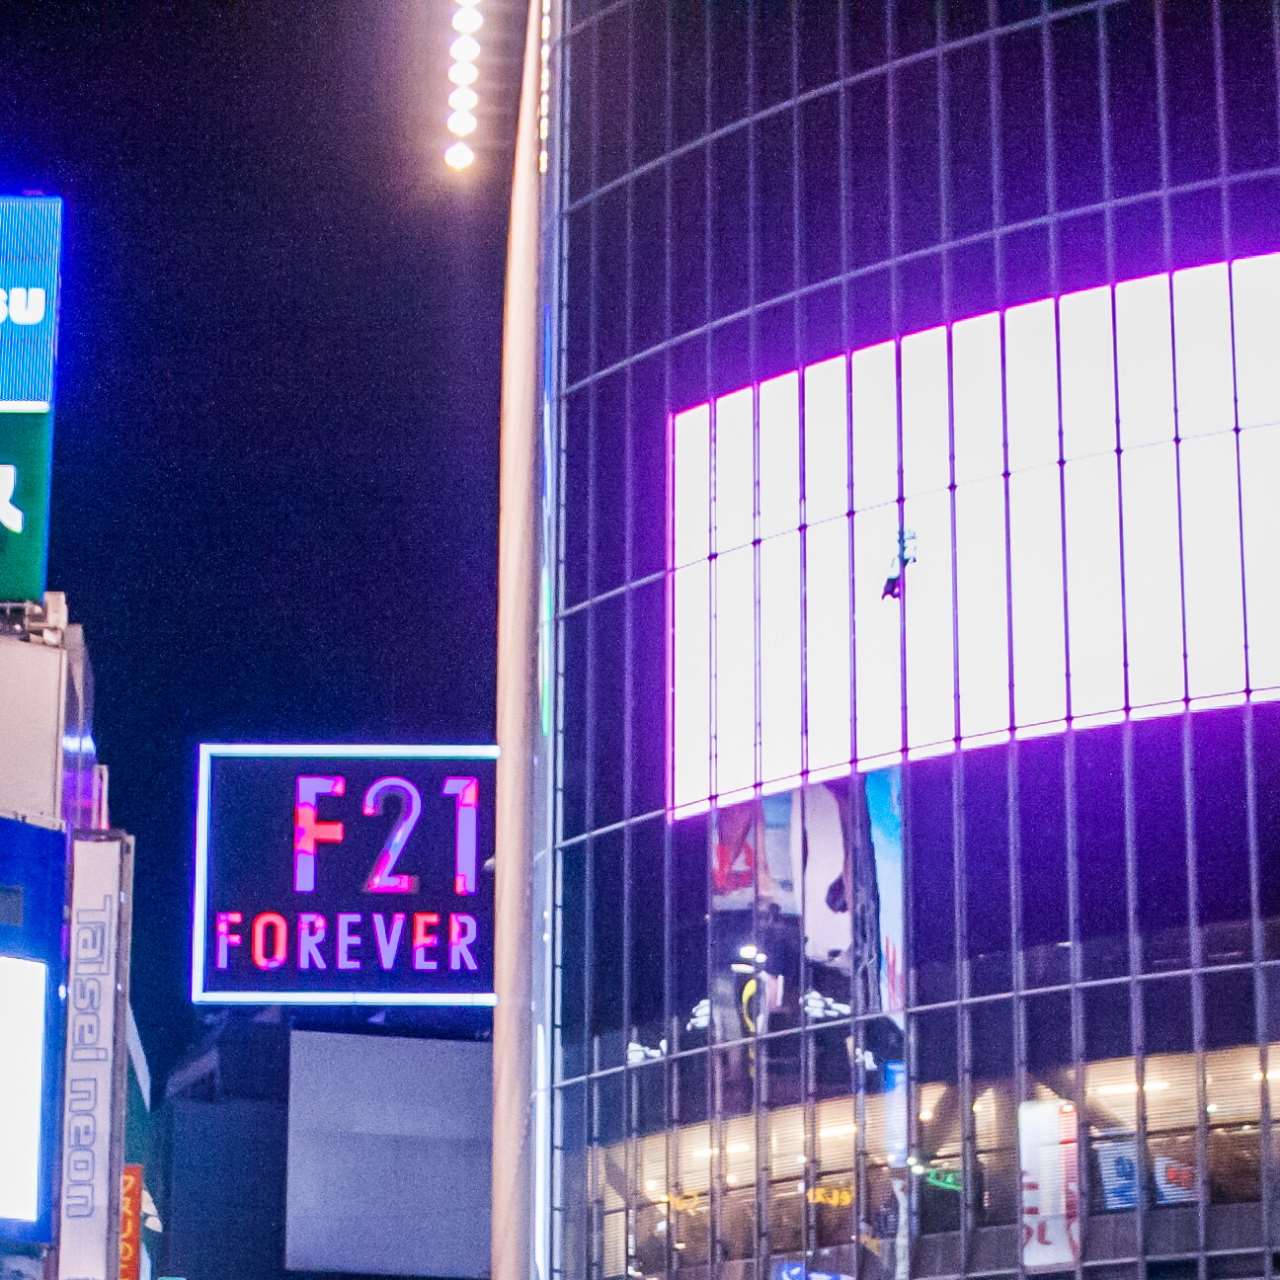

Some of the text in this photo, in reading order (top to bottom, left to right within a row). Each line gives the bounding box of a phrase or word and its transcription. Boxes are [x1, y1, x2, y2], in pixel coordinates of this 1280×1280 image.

[293, 775, 480, 895] F21
[216, 911, 479, 971] FOREVER
[65, 1076, 98, 1220] neon
